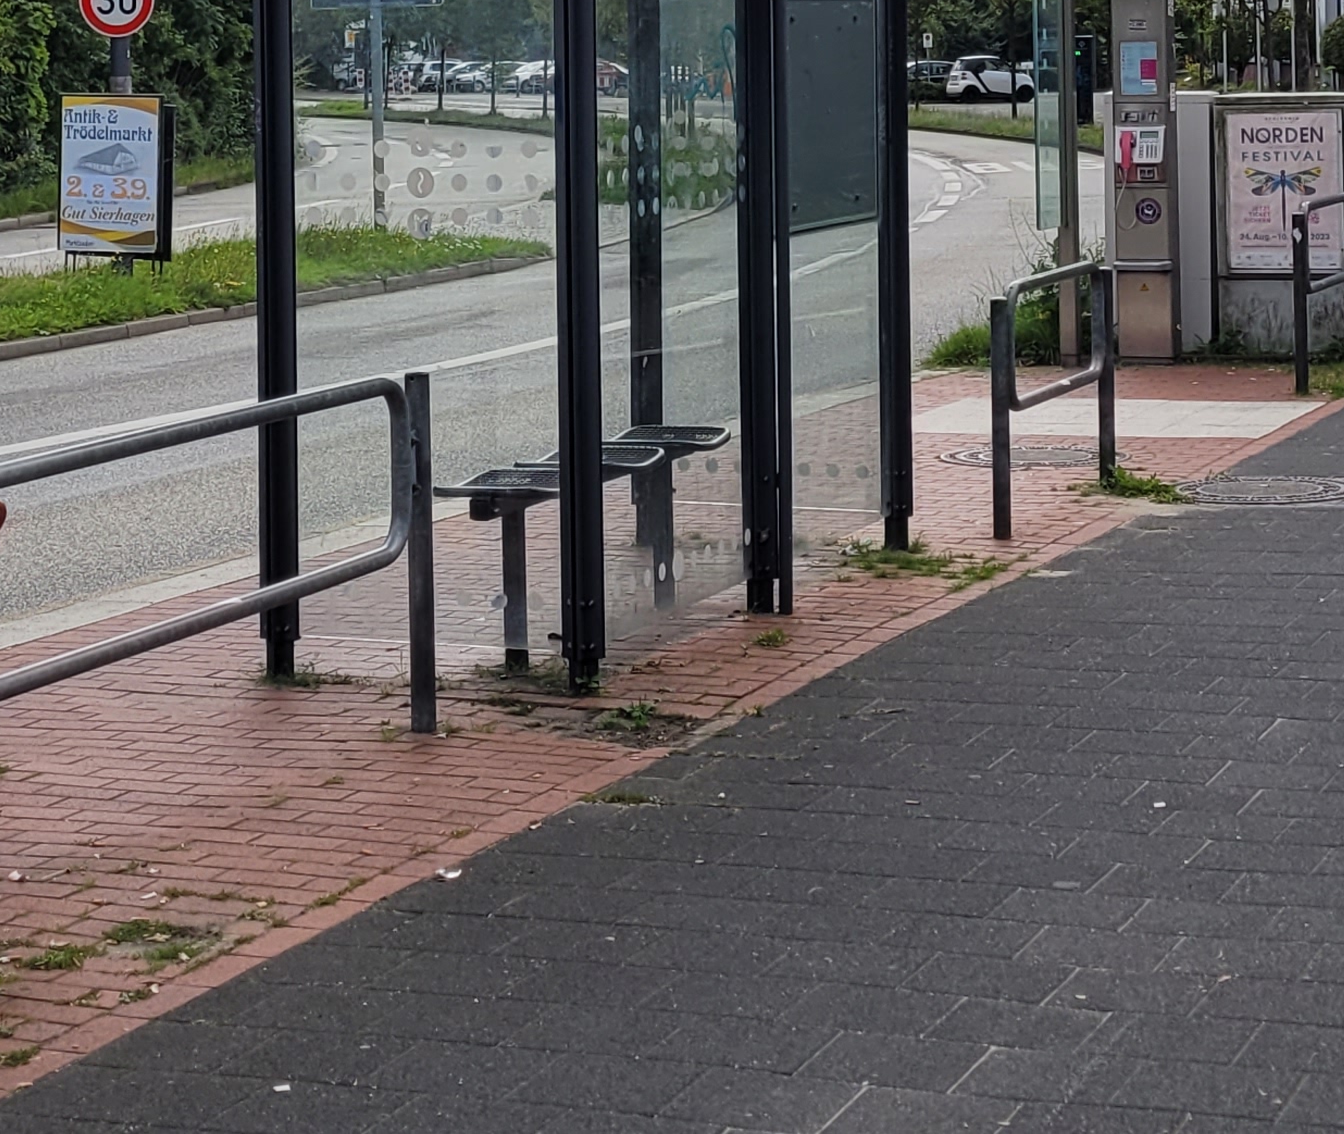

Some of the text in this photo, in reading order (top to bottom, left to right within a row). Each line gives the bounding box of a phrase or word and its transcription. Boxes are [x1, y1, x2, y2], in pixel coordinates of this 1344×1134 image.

[63, 108, 119, 125] Antik- &
[63, 125, 154, 142] Trödelmarkt
[1240, 126, 1324, 144] NORDEN
[1241, 150, 1325, 162] FESTIVAL
[65, 175, 88, 198] 2.
[62, 205, 155, 226] Gut Sierhagen
